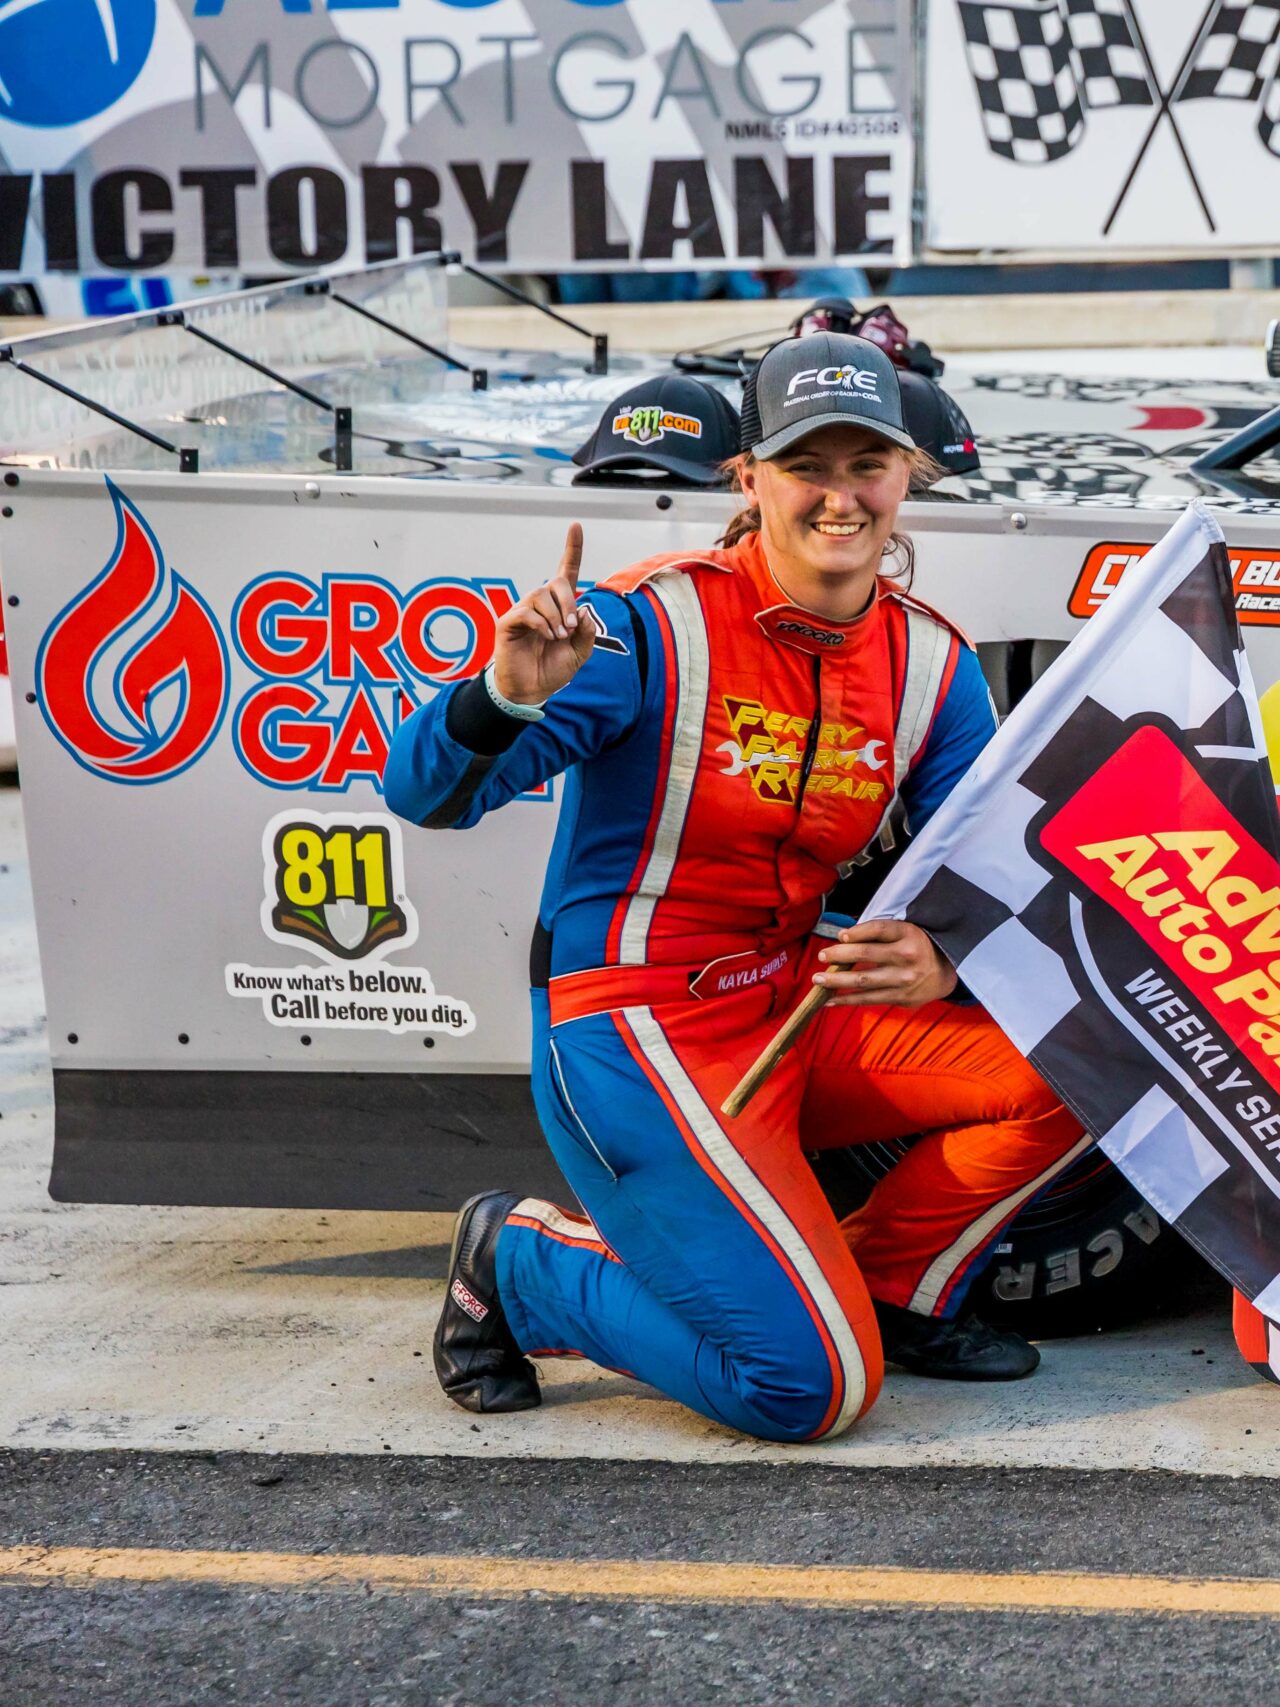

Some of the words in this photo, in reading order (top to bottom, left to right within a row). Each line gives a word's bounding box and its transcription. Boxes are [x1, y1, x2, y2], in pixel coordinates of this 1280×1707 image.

[196, 24, 900, 132] MORTGAGE
[569, 152, 896, 263] LANE
[730, 704, 866, 746] FERRY
[739, 733, 860, 770] FARM
[751, 760, 885, 801] REPAIR
[281, 828, 388, 908] 811
[1075, 833, 1233, 974] Auto
[233, 972, 282, 990] Know
[286, 974, 345, 992] what's
[348, 969, 427, 994] below.
[718, 967, 758, 991] KAYLA
[271, 993, 320, 1020] Call
[325, 1001, 388, 1021] before
[394, 1005, 428, 1026] you
[432, 1004, 468, 1028] dig.
[1124, 967, 1253, 1093] WEEKLY
[453, 1281, 487, 1317] G-FORCE
